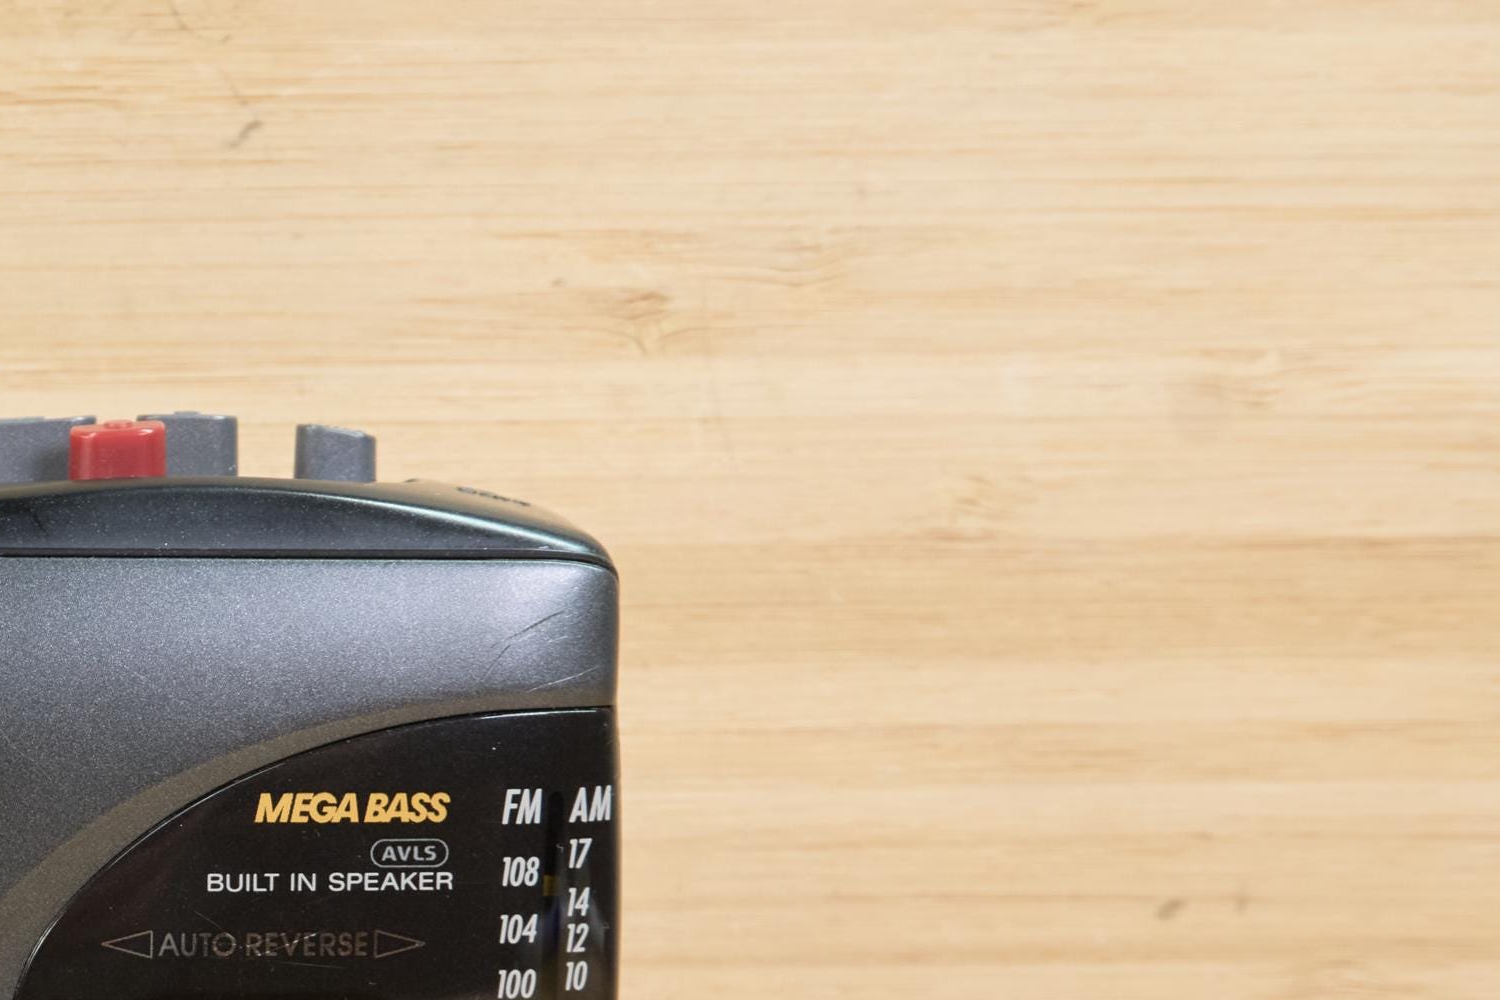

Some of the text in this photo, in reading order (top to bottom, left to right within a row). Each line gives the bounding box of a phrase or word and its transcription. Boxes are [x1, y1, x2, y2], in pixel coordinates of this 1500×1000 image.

[254, 791, 451, 823] MEGA BASS
[501, 788, 543, 825] FM
[568, 784, 612, 823] AM
[381, 845, 438, 862] AVLS
[568, 838, 592, 869] 17
[206, 871, 454, 893] BUILT IN SPEAKER
[502, 856, 540, 887] 108
[567, 886, 590, 917] 14
[158, 932, 368, 957] AUTO REVERSE
[499, 914, 538, 944] 104
[566, 923, 589, 953] 12
[497, 968, 536, 999] 100
[564, 960, 588, 991] 10
